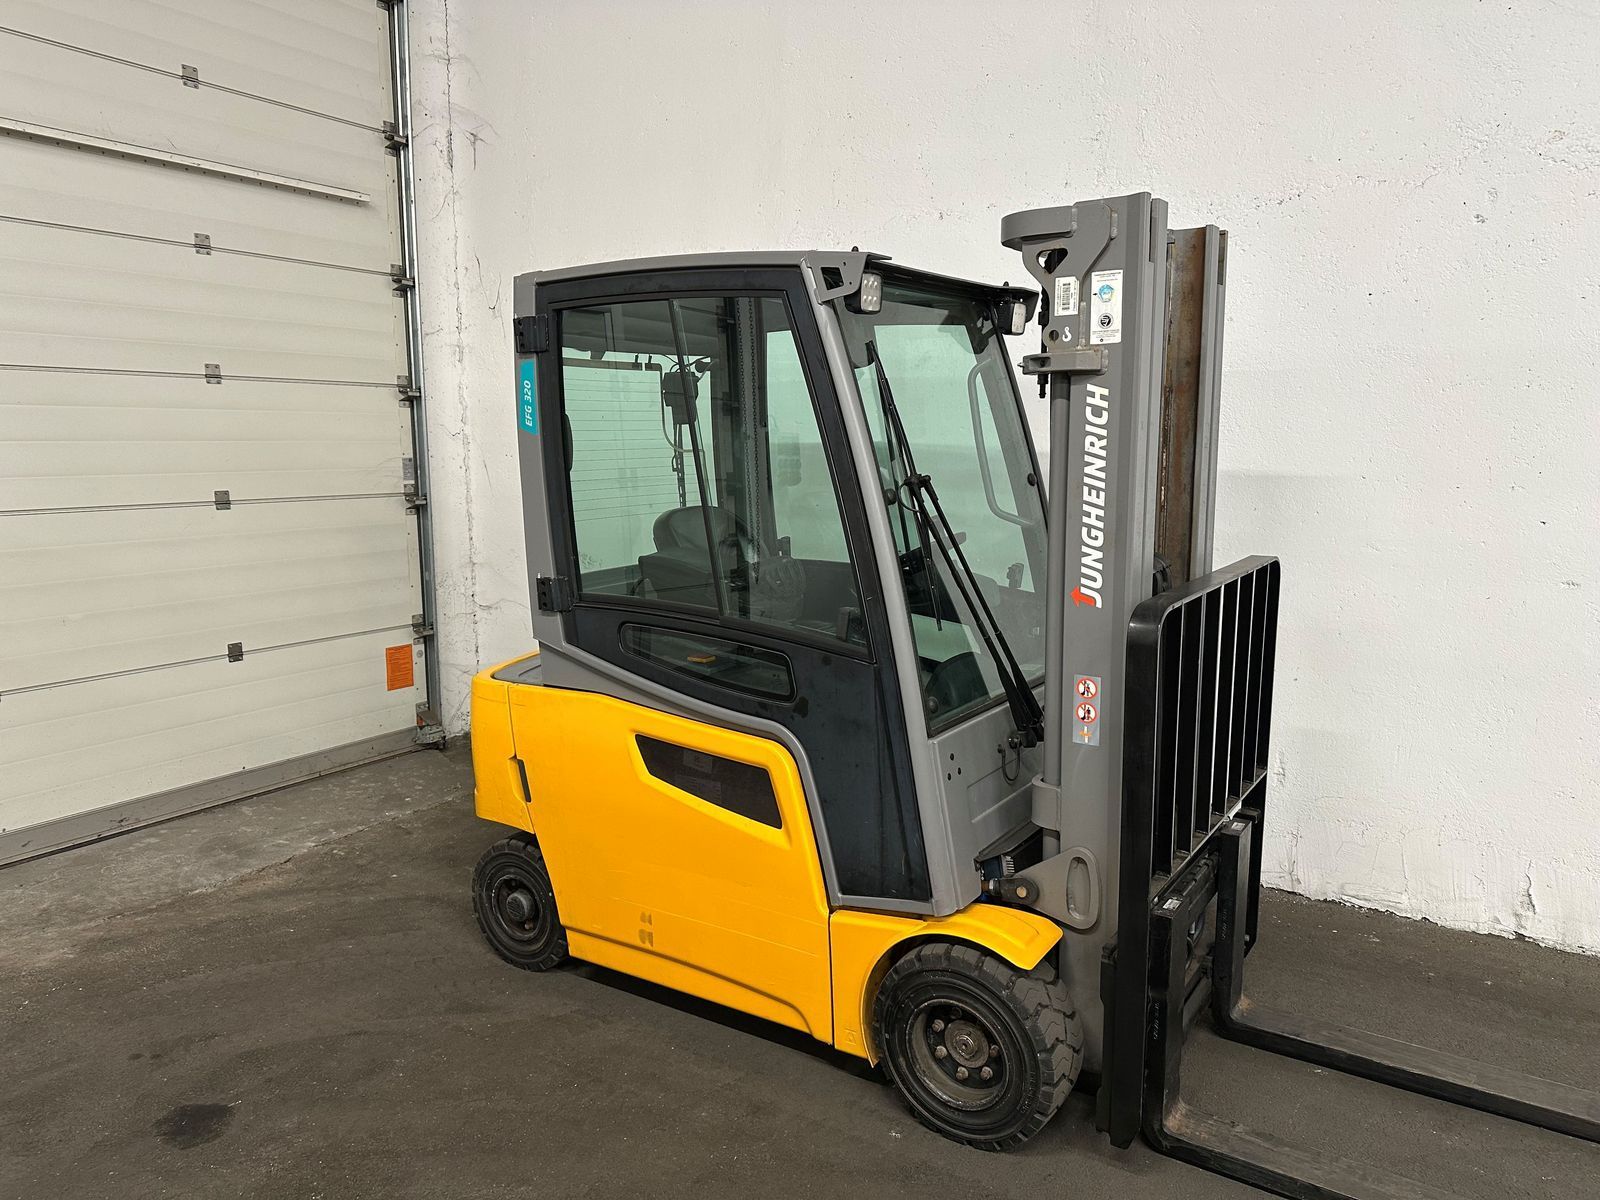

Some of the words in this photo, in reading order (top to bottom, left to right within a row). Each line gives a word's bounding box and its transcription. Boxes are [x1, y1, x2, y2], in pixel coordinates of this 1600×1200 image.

[523, 379, 532, 403] 320
[524, 405, 533, 427] EFG
[1071, 383, 1110, 609] JUNGHEINRICH
